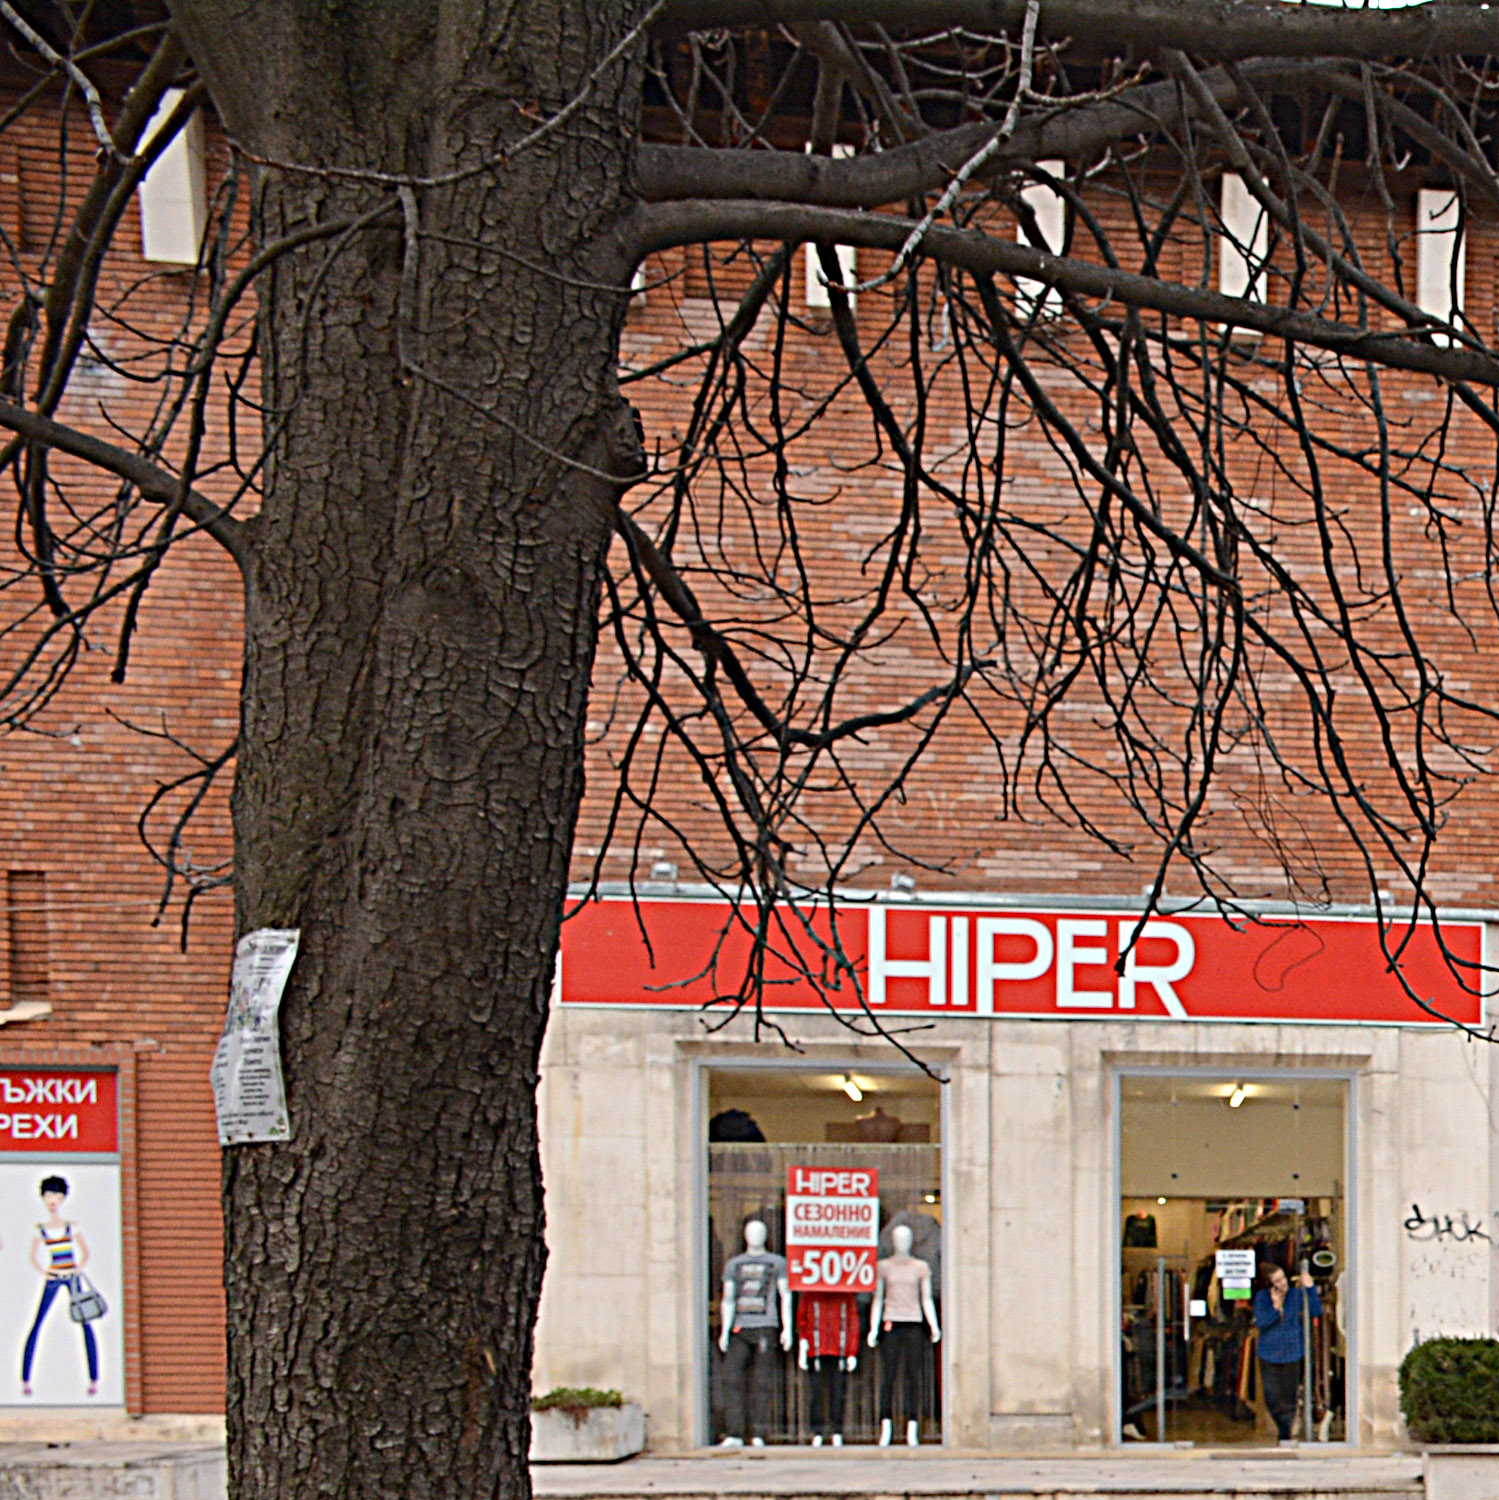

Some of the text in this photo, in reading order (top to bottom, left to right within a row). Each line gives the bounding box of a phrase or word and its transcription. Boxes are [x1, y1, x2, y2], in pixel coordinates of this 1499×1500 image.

[868, 905, 1196, 1018] HIPER
[795, 1169, 871, 1196] HIPER
[794, 1203, 872, 1222] СЕЗОННО
[793, 1225, 871, 1239] НАМАЛЕНИЕ
[790, 1250, 874, 1286] -50%
